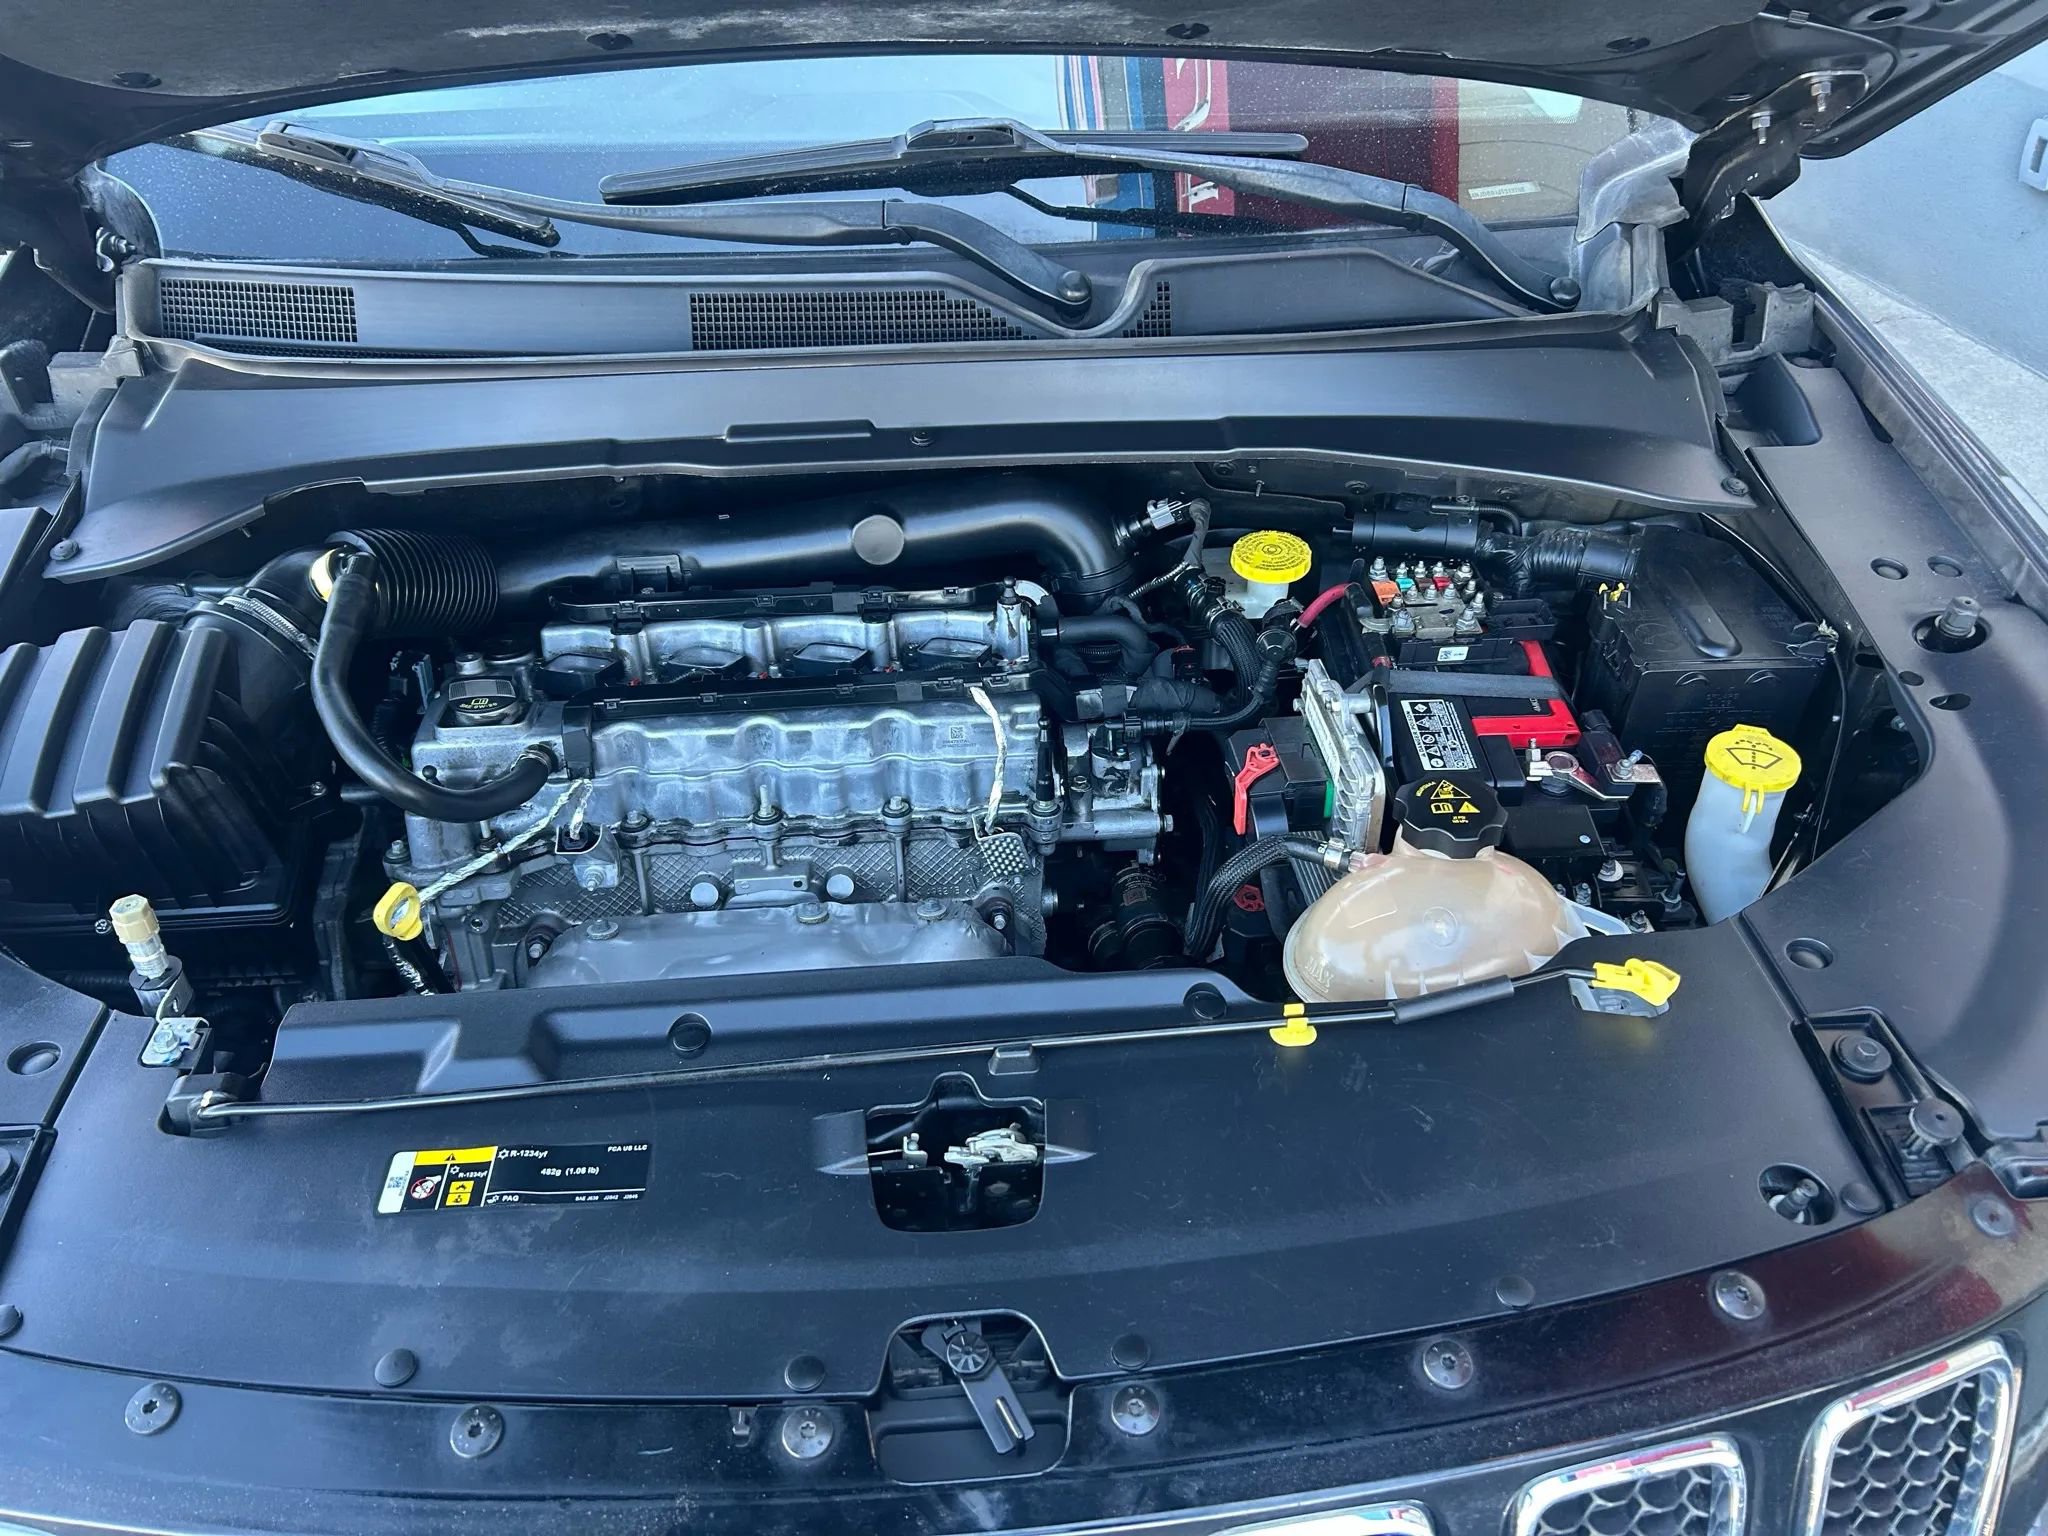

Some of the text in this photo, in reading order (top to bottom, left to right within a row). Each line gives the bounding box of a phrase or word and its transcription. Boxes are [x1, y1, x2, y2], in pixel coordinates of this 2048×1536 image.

[510, 1150, 548, 1159] R-1234yf
[458, 1170, 488, 1178] R-1234yf
[540, 1168, 562, 1176] 482g
[588, 1166, 600, 1175] lb)
